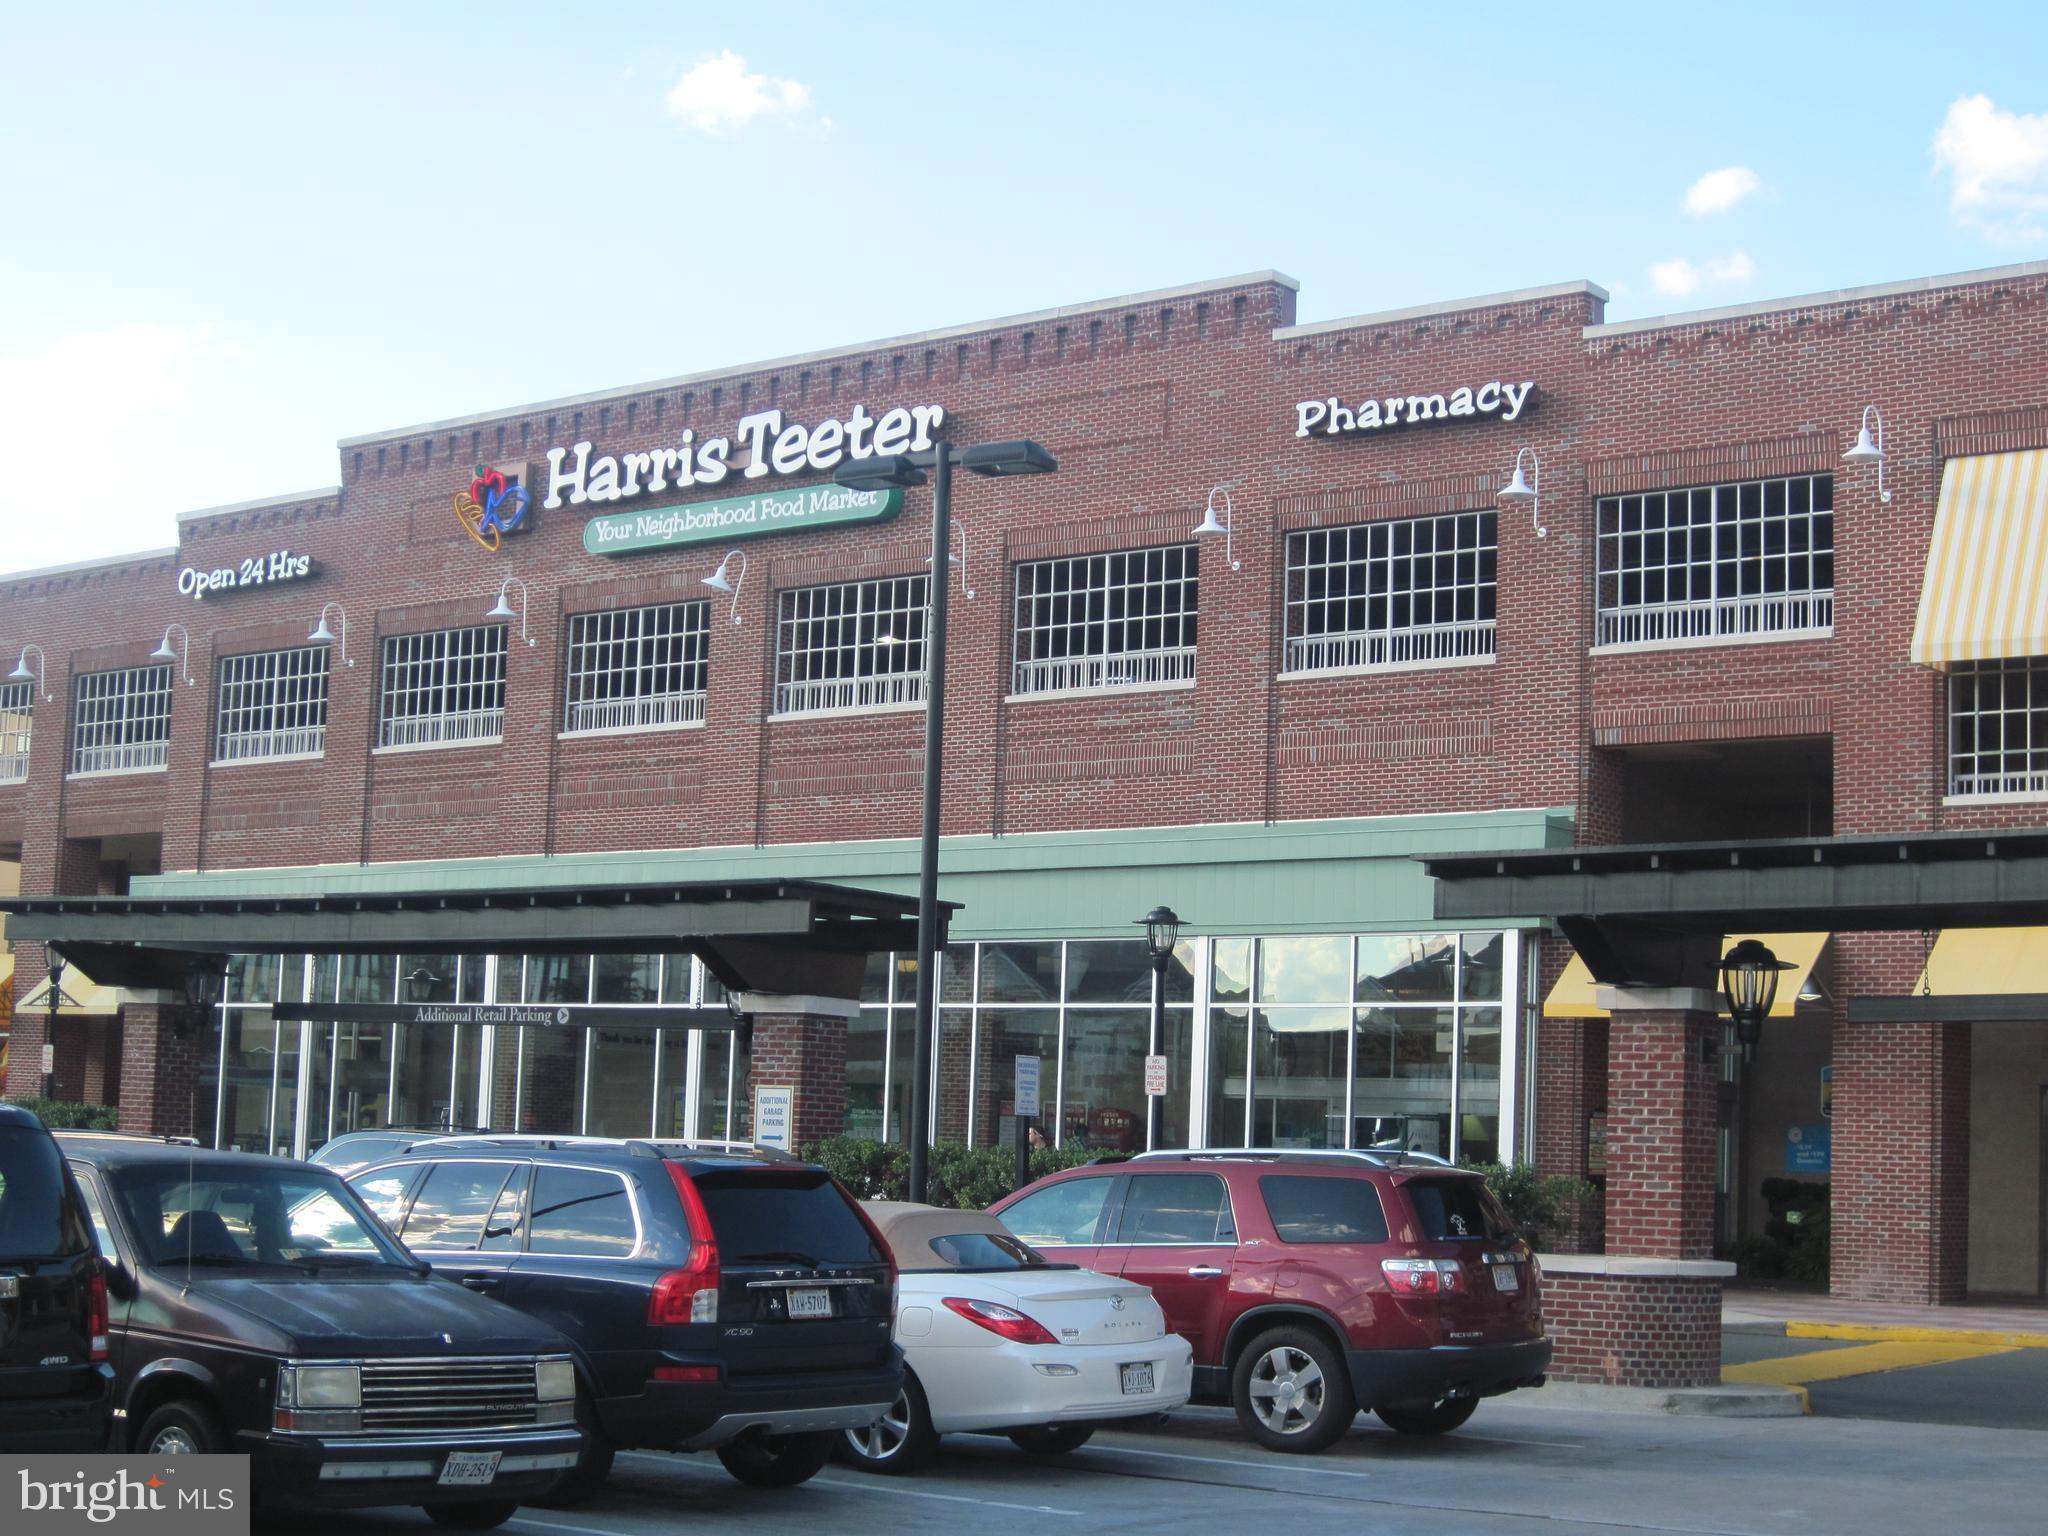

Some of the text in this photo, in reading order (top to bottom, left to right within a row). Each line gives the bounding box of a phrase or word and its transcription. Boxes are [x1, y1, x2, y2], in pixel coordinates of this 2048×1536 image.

[1295, 381, 1534, 437] Pharmacy
[543, 404, 944, 509] Harris Teeter
[595, 488, 877, 542] Your Neighborhood Food Market
[178, 550, 309, 599] Open 24 Hrs
[415, 1007, 552, 1026] Additional Retail Parking
[760, 1096, 788, 1104] ADDITIONAL
[764, 1107, 783, 1115] GARAGE
[762, 1118, 784, 1126] PARKING
[775, 1270, 853, 1278] VOLVO
[790, 1295, 827, 1311] XAW-5707
[40, 1355, 69, 1366] 4WD
[443, 1461, 497, 1478] XDH-2519
